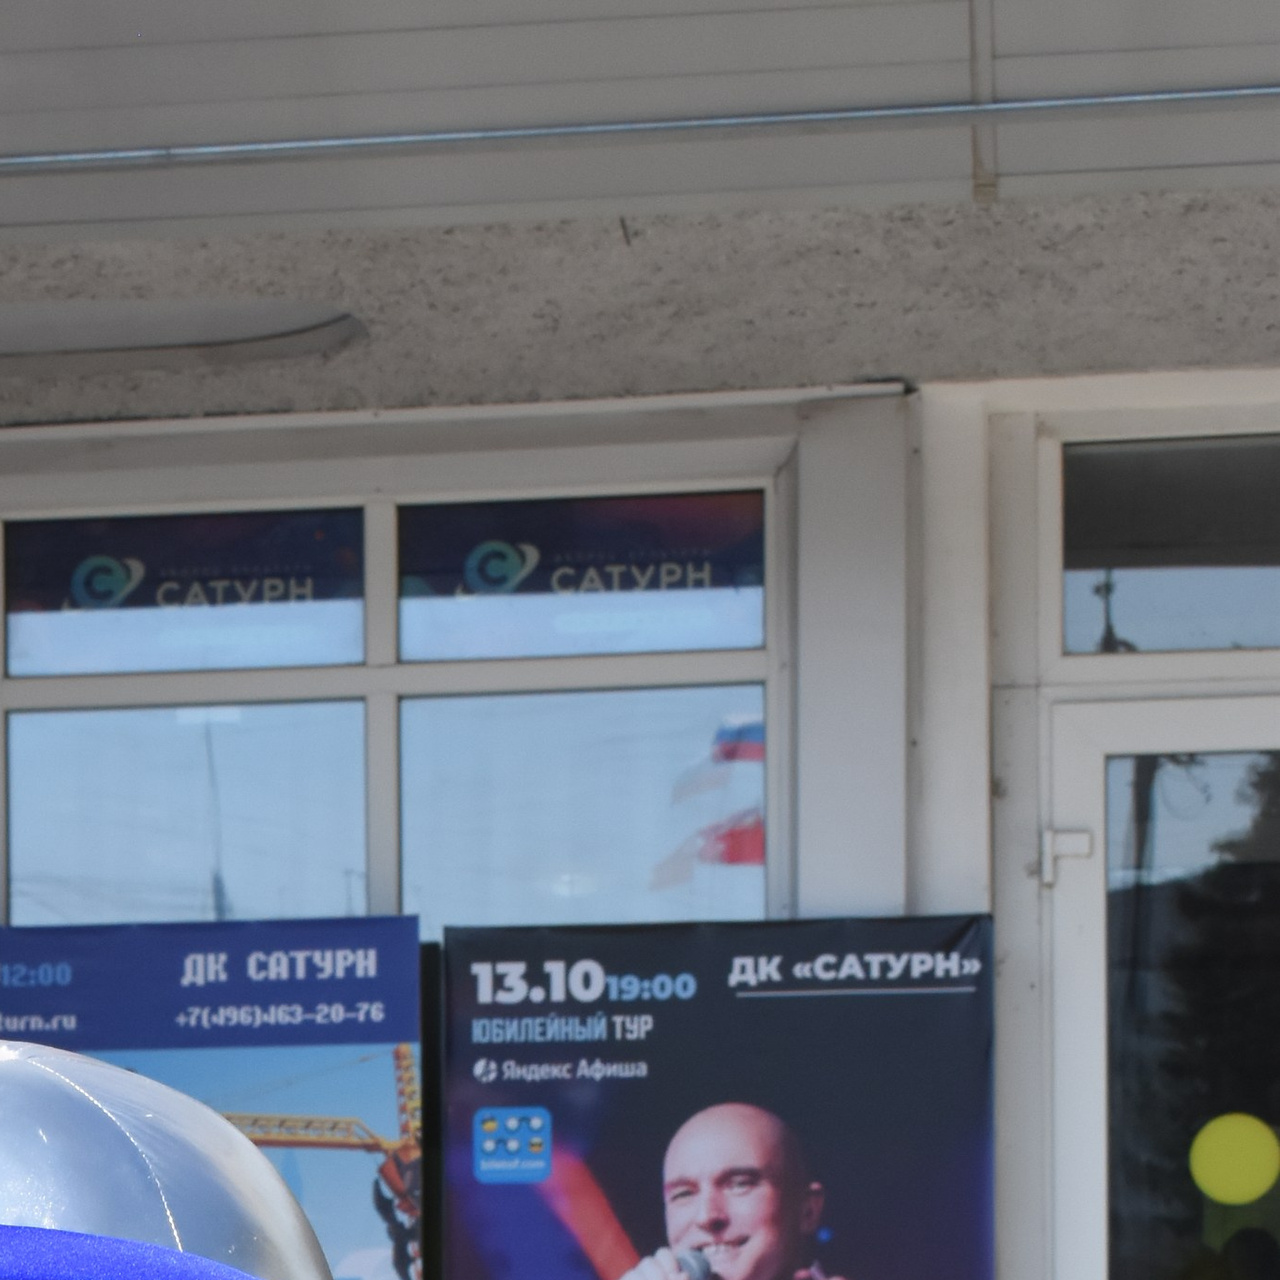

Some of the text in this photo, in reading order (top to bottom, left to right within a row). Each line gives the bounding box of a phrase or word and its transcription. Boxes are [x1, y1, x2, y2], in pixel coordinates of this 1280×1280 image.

[155, 577, 313, 607] САТУРН
[550, 561, 711, 594] САТУРН
[1, 962, 72, 988] 12:00
[180, 948, 378, 987] ДК САТУРН
[470, 958, 697, 1005] 13.10 19:00
[727, 951, 982, 987] ДК «САТУРН»
[472, 1011, 654, 1043] ЮБИЛЕЙНЫЙ ТУР
[501, 1057, 648, 1082] Яндекс Афиша
